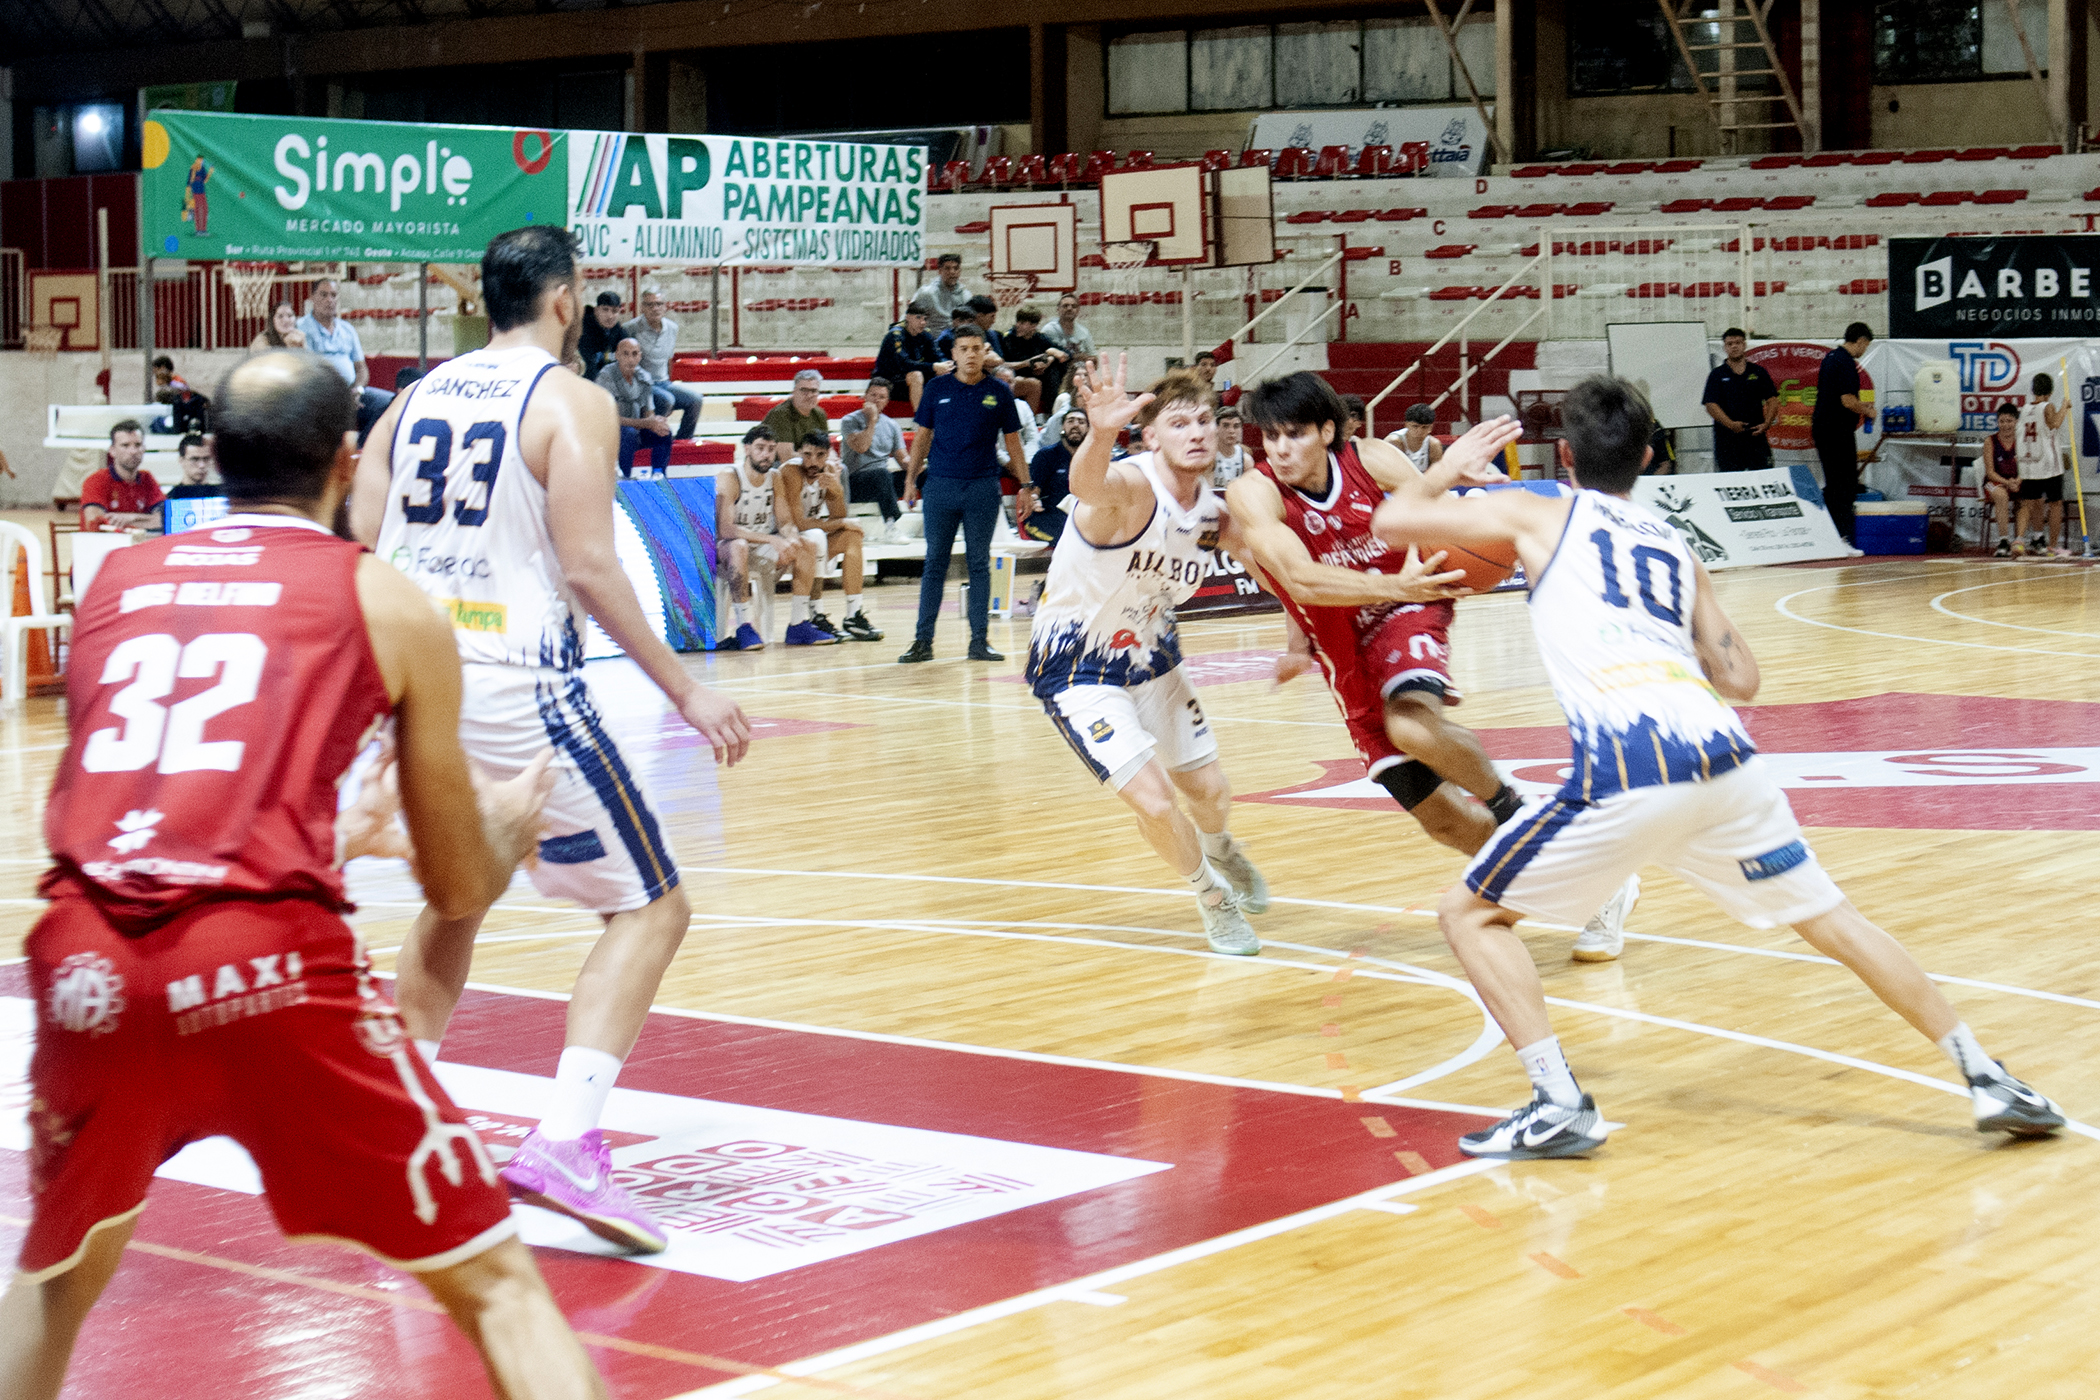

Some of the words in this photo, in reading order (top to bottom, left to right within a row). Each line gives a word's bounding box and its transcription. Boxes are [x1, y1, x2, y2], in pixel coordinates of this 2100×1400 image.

[274, 134, 473, 212] Simple
[606, 134, 712, 219] AP
[724, 140, 922, 184] ABERTURAS
[1476, 179, 1488, 194] D
[723, 182, 922, 226] PAMPEANAS
[285, 219, 365, 234] MERCADO
[371, 221, 460, 235] MAYORISTA
[574, 223, 610, 258] PVC
[633, 225, 723, 260] ALUMINIO
[744, 227, 830, 261] SISTEMAS
[834, 230, 922, 262] VIDRIADOS
[1433, 220, 1446, 235] C
[1390, 260, 1402, 275] B
[1346, 303, 1360, 319] A
[1956, 309, 2043, 321] NEGOCIOS
[1790, 347, 1827, 360] VERD
[427, 371, 521, 399] SANCHEZ
[402, 417, 507, 527] 33
[1171, 555, 1205, 586] BO
[1590, 527, 1684, 628] 10
[82, 632, 268, 775] 32
